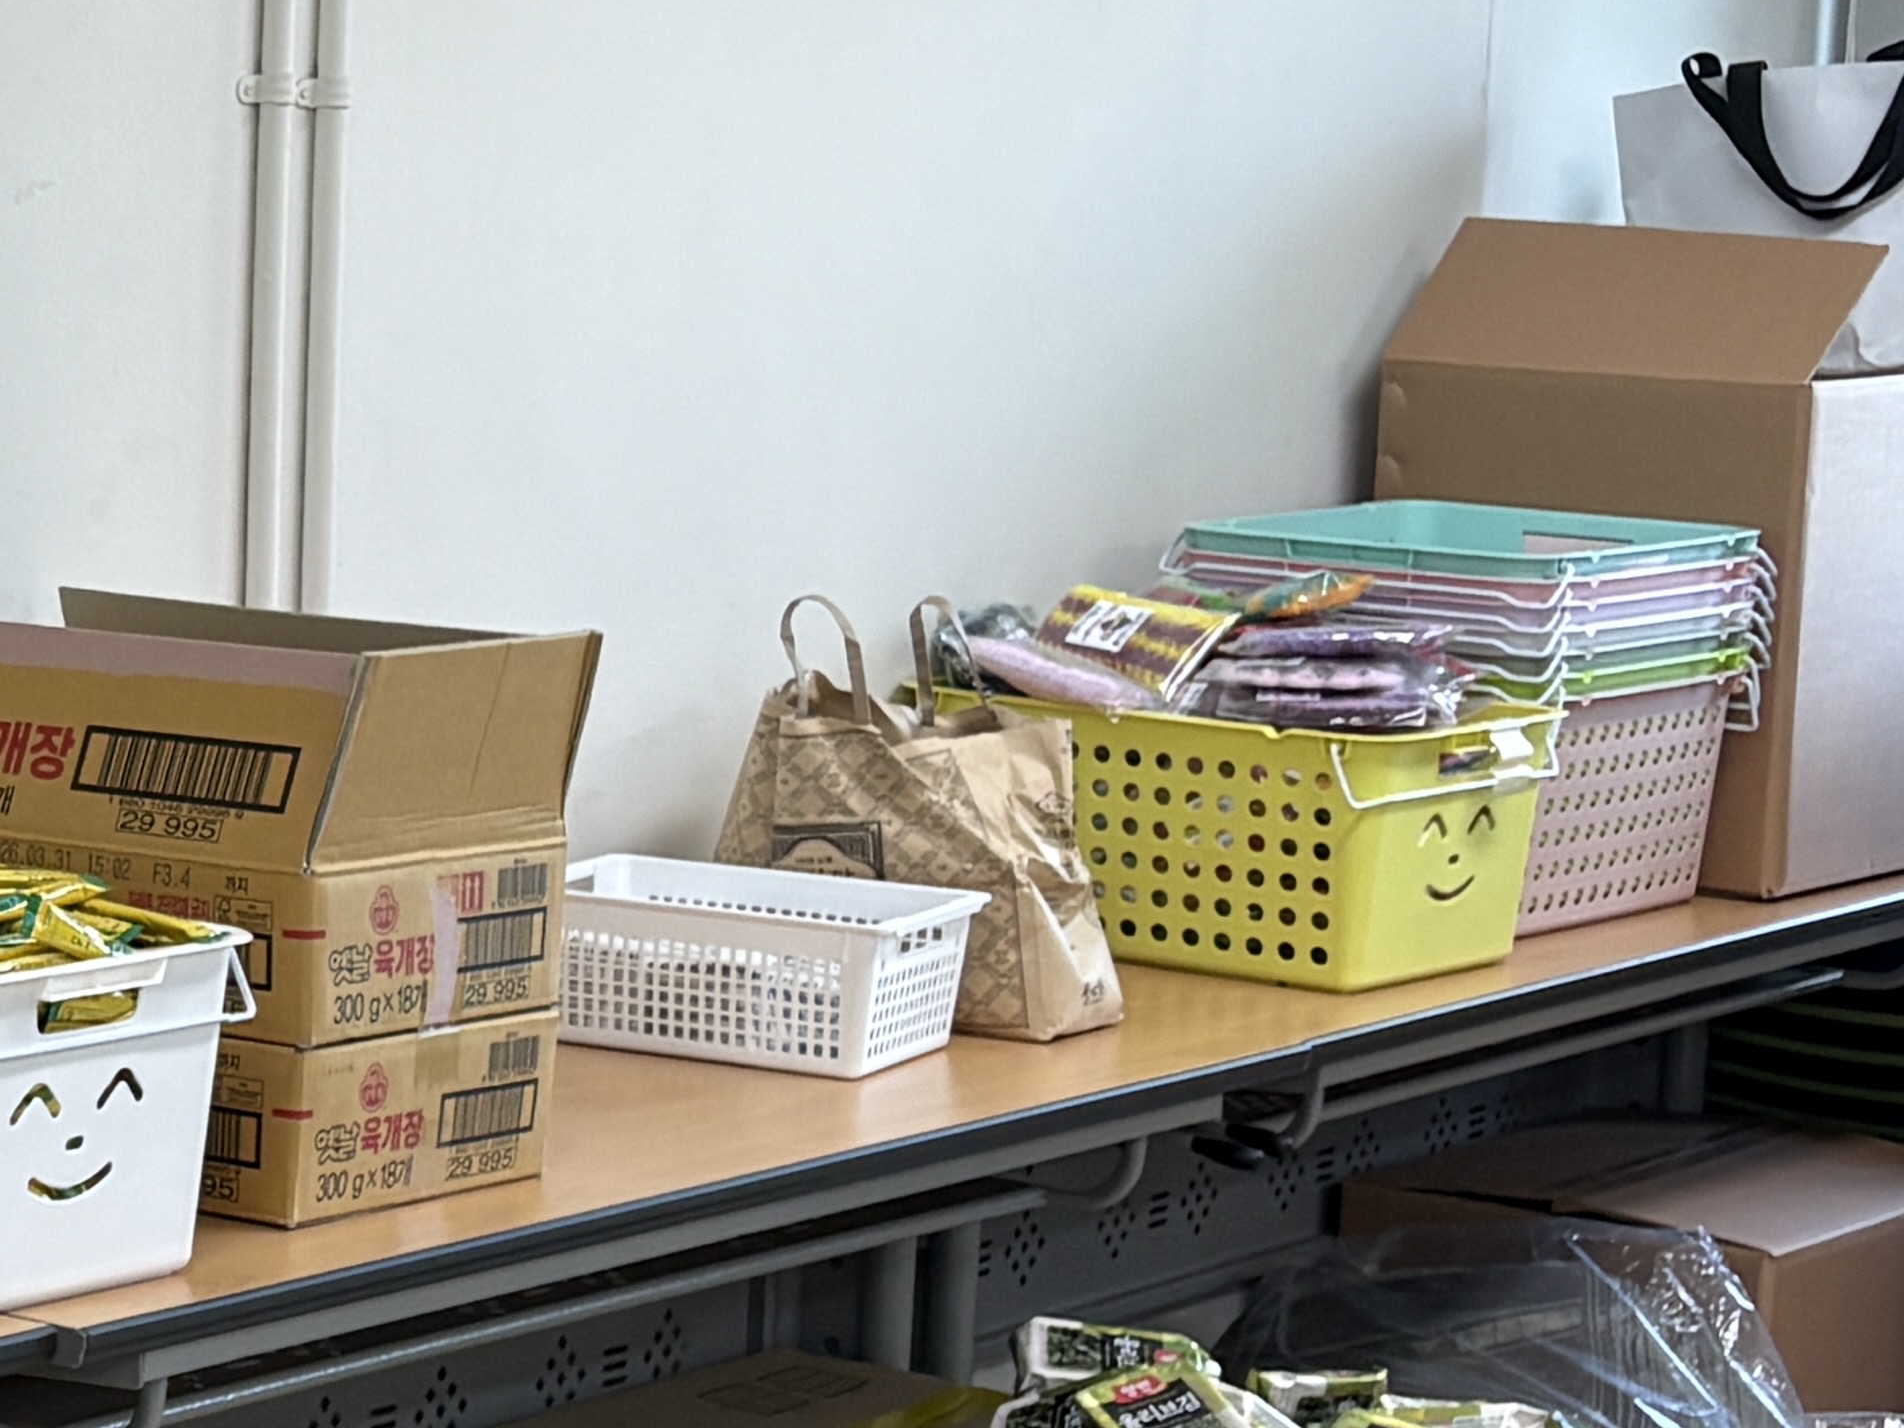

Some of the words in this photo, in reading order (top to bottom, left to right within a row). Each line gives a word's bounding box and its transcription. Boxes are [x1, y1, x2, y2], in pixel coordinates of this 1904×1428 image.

[118, 808, 157, 830] 29
[163, 814, 217, 840] 995
[328, 943, 373, 987] 옛날
[334, 993, 365, 1024] 300
[465, 982, 487, 1007] 29
[494, 978, 529, 1001] 995
[314, 1121, 361, 1166] 옛날
[360, 1108, 425, 1155] 육개장
[446, 1155, 473, 1182] 29
[478, 1148, 514, 1174] 995
[316, 1170, 349, 1203] 300
